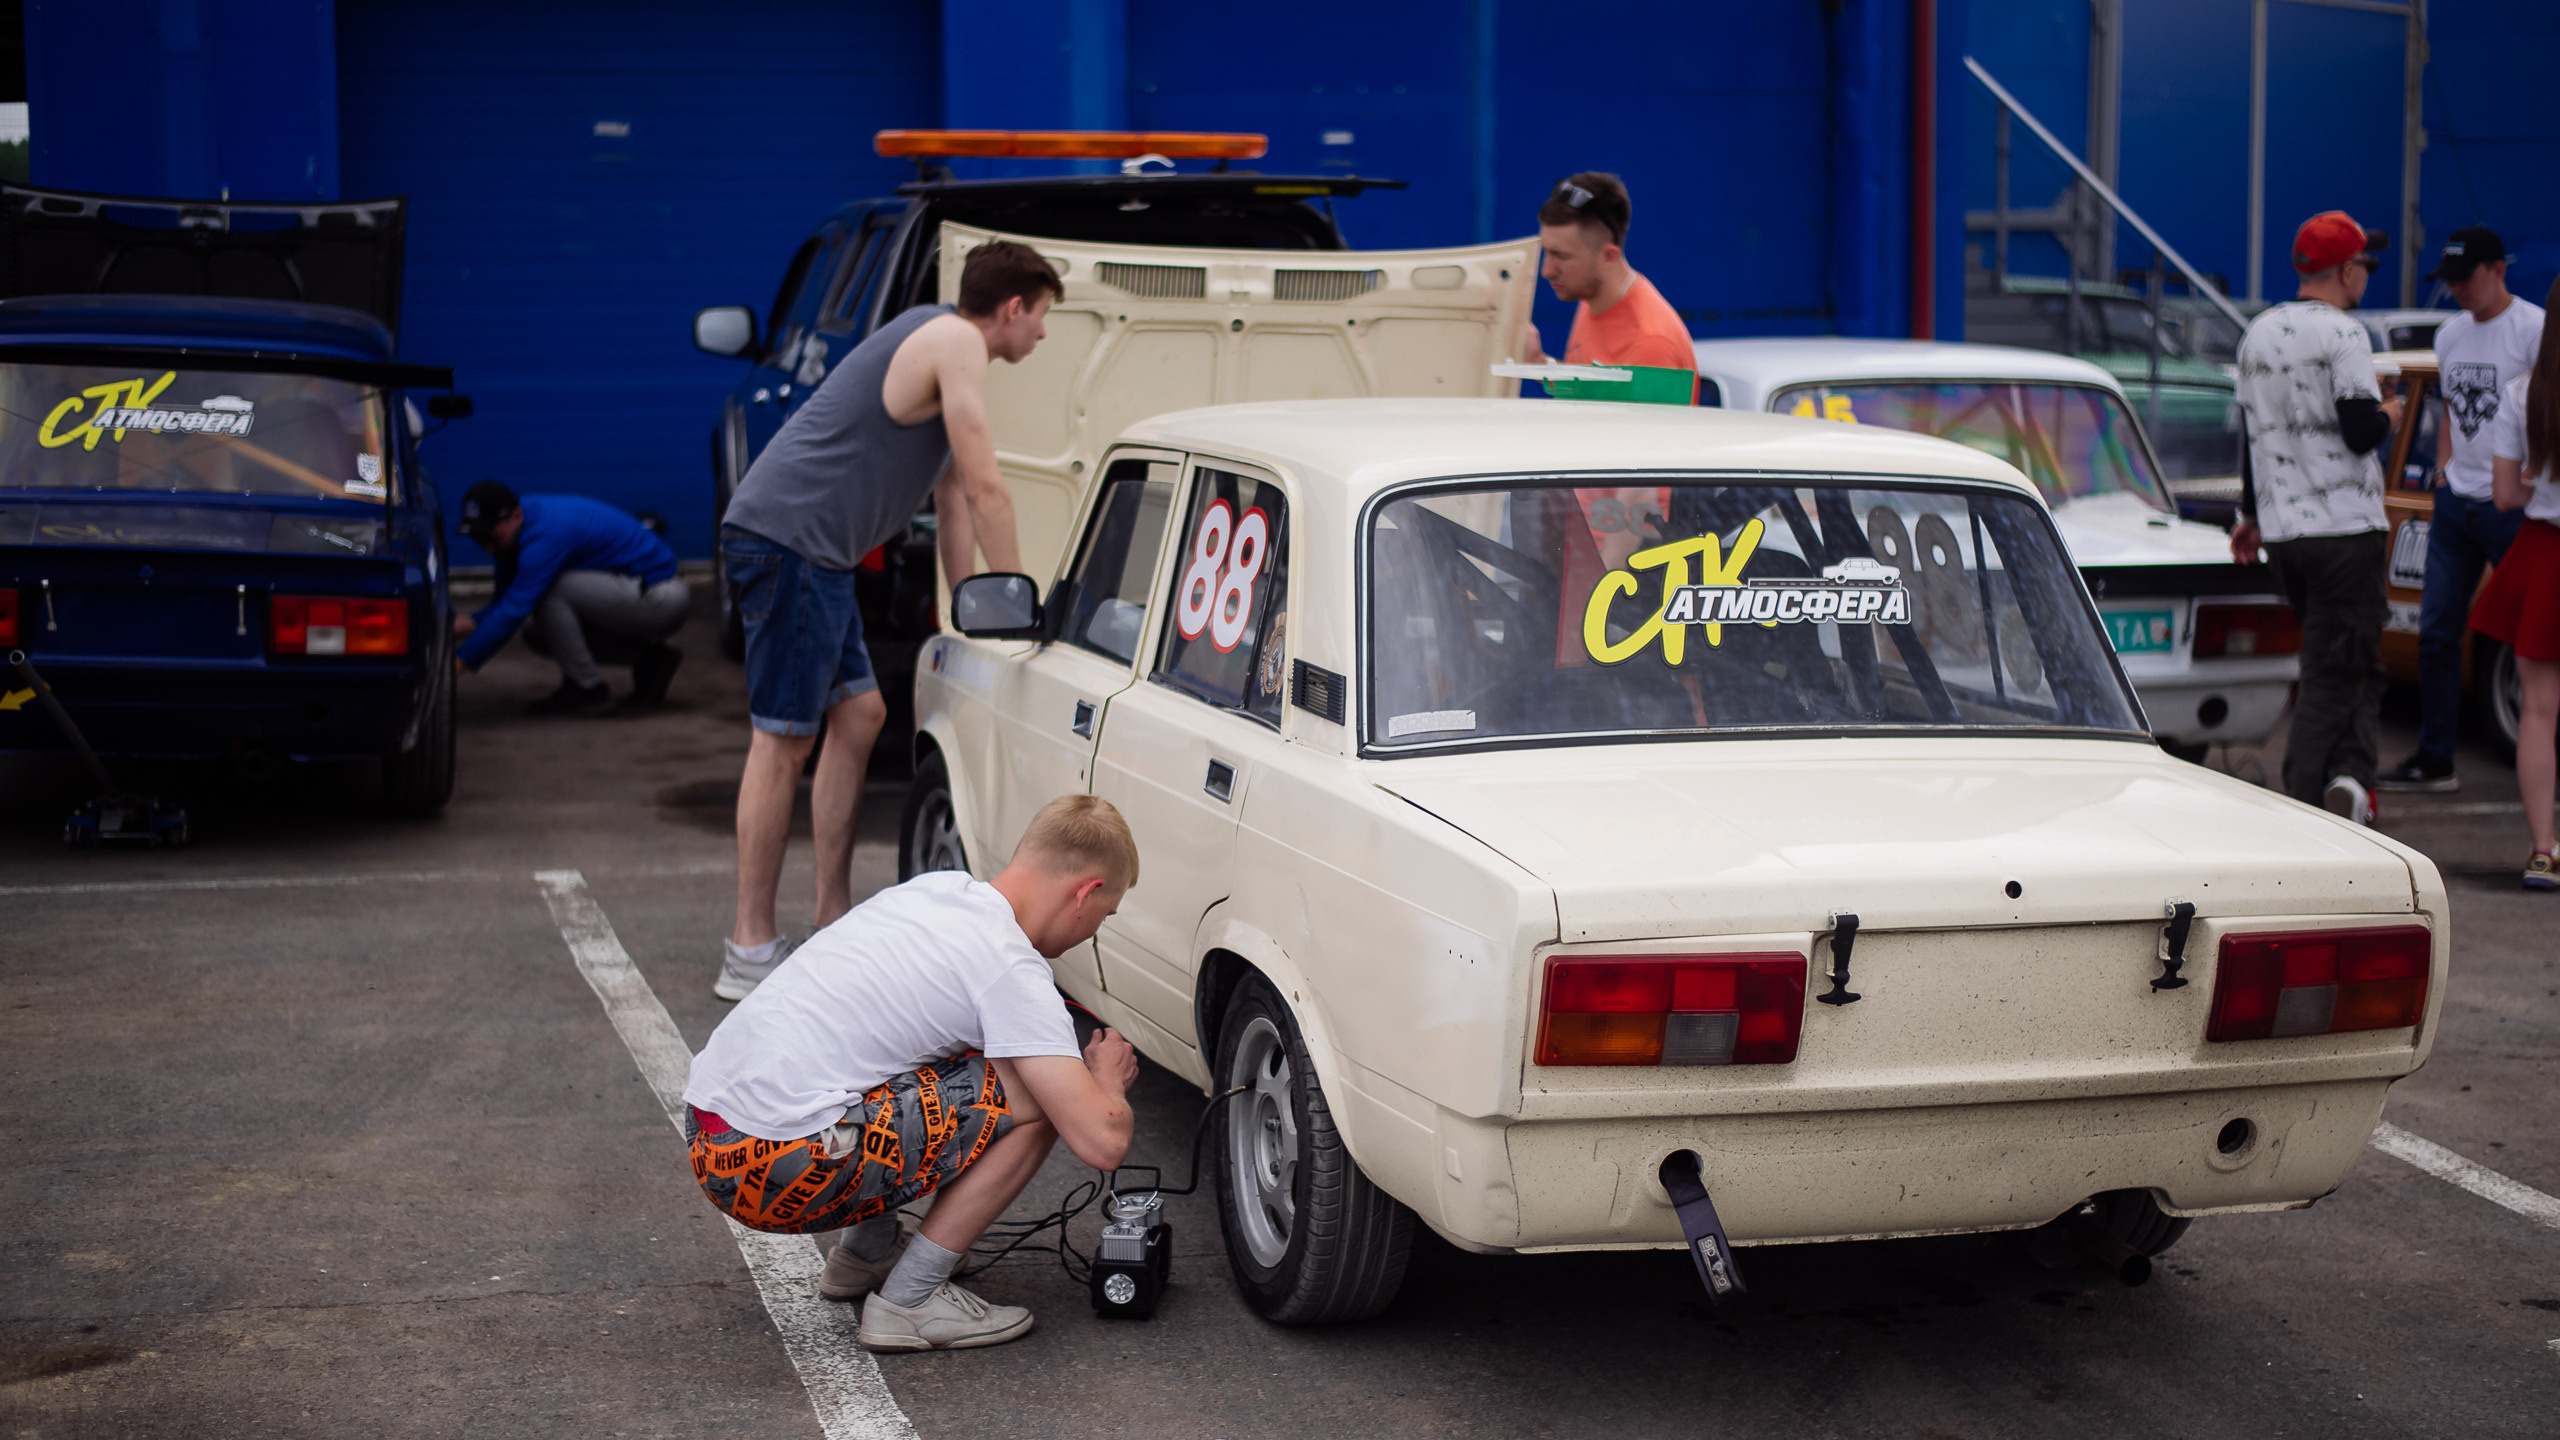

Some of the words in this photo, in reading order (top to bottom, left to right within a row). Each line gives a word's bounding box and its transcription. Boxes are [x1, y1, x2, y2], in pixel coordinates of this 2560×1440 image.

[92, 408, 251, 435] АТМОСФЕРА
[1177, 497, 1270, 655] 88
[1665, 588, 1908, 622] АТМОСФЕРА
[981, 1116, 996, 1144] READY
[714, 1146, 749, 1171] NEVER
[772, 1185, 815, 1220] GIVE
